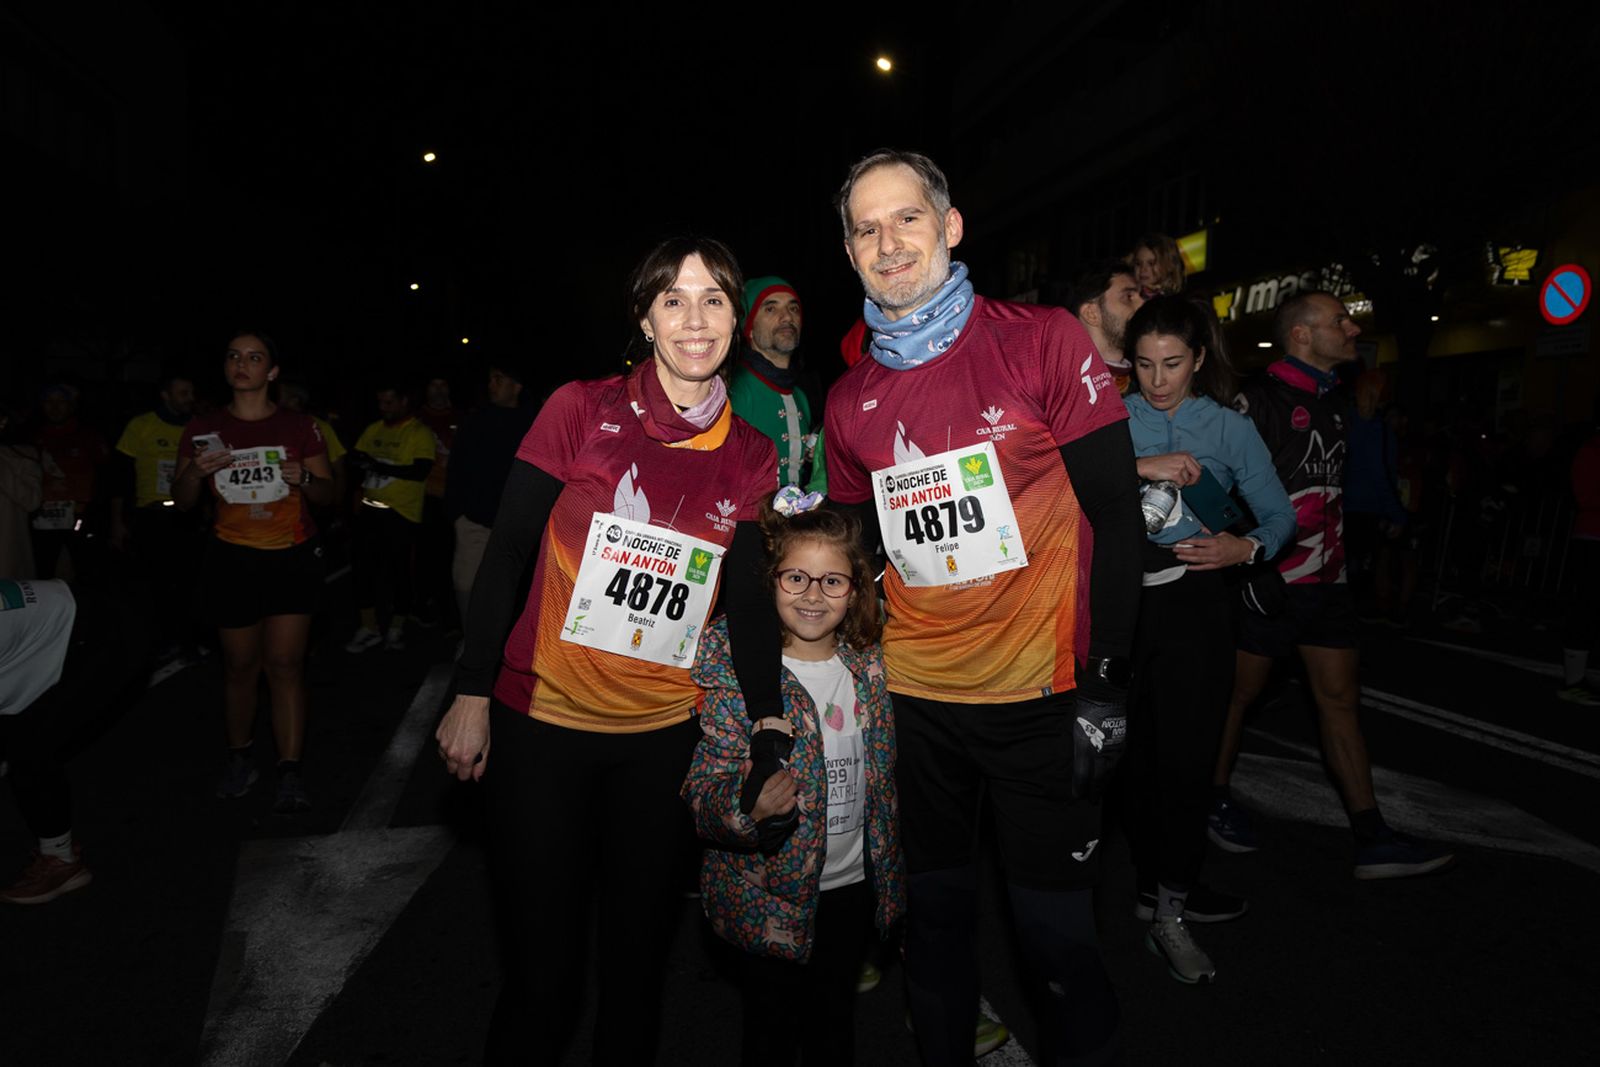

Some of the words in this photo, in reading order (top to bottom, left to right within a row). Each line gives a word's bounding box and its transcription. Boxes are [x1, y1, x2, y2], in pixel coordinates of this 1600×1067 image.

[229, 466, 274, 485] 4243
[897, 473, 931, 491] NOCHE
[933, 469, 948, 483] DE
[889, 494, 909, 511] SAN
[912, 483, 952, 506] ANTÓN
[905, 495, 986, 545] 4879
[622, 535, 665, 555] NOCHE
[665, 546, 681, 560] DE
[935, 542, 960, 553] Felipe
[601, 546, 631, 565] SAN
[631, 554, 677, 577] ANTÓN
[604, 567, 690, 621] 4878
[627, 613, 656, 628] Beatriz
